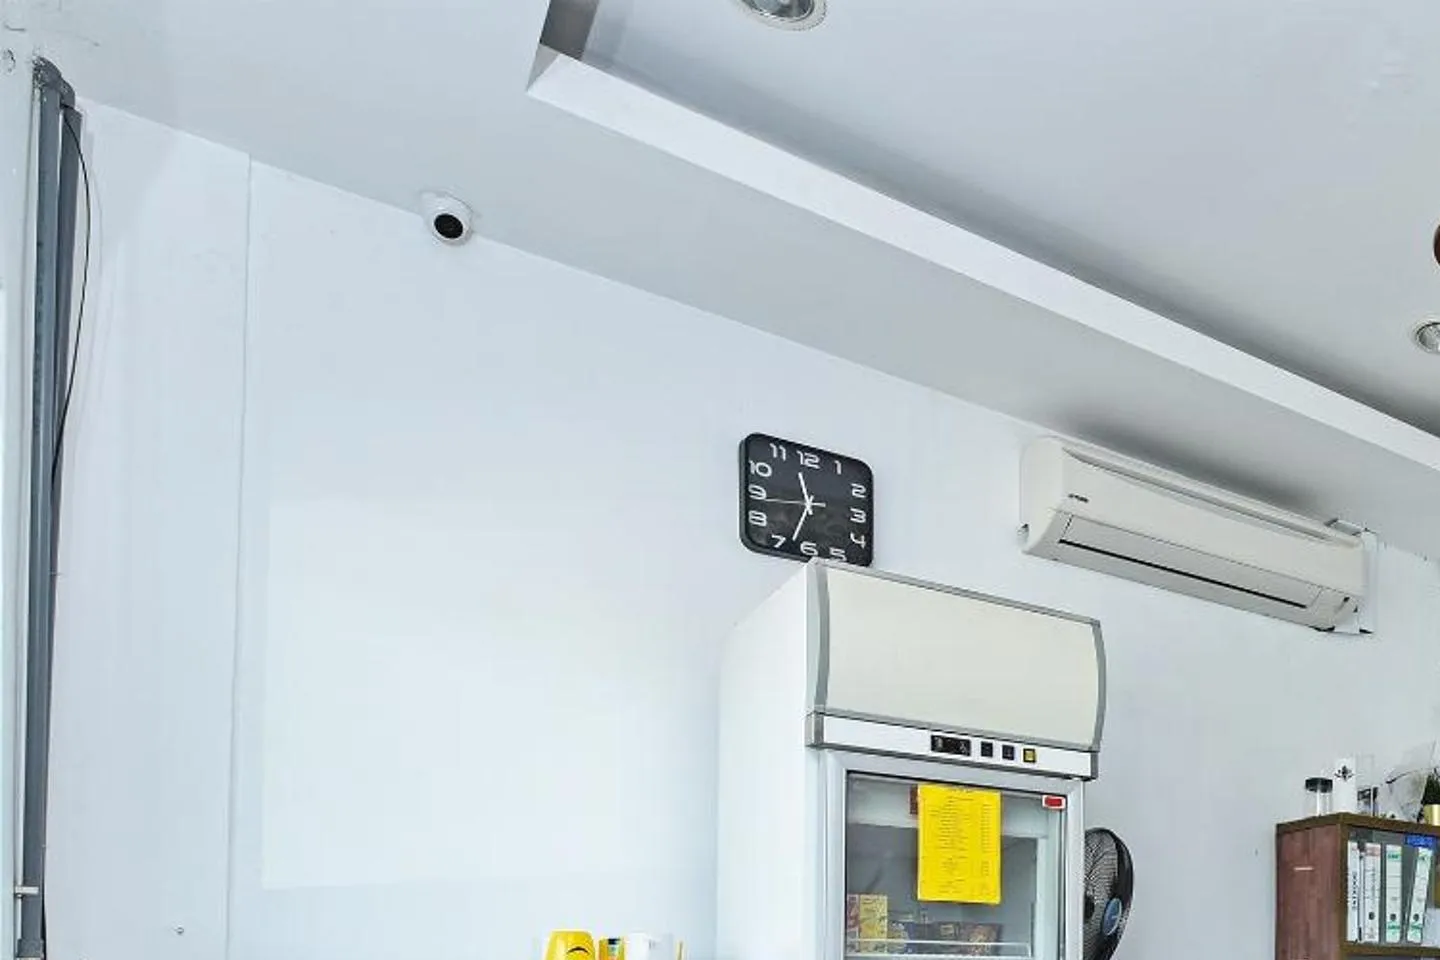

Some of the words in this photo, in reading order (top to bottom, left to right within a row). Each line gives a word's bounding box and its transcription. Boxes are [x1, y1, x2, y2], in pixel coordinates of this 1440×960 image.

[770, 443, 786, 461] 11
[797, 450, 820, 469] 12
[749, 460, 772, 477] 10
[835, 460, 842, 475] 1
[748, 484, 767, 500] 9
[851, 483, 866, 498] 2
[748, 510, 767, 527] 8
[850, 508, 866, 523] 3
[771, 534, 786, 548] 7
[800, 541, 818, 556] 6
[850, 533, 866, 549] 4
[829, 547, 847, 561] 5
